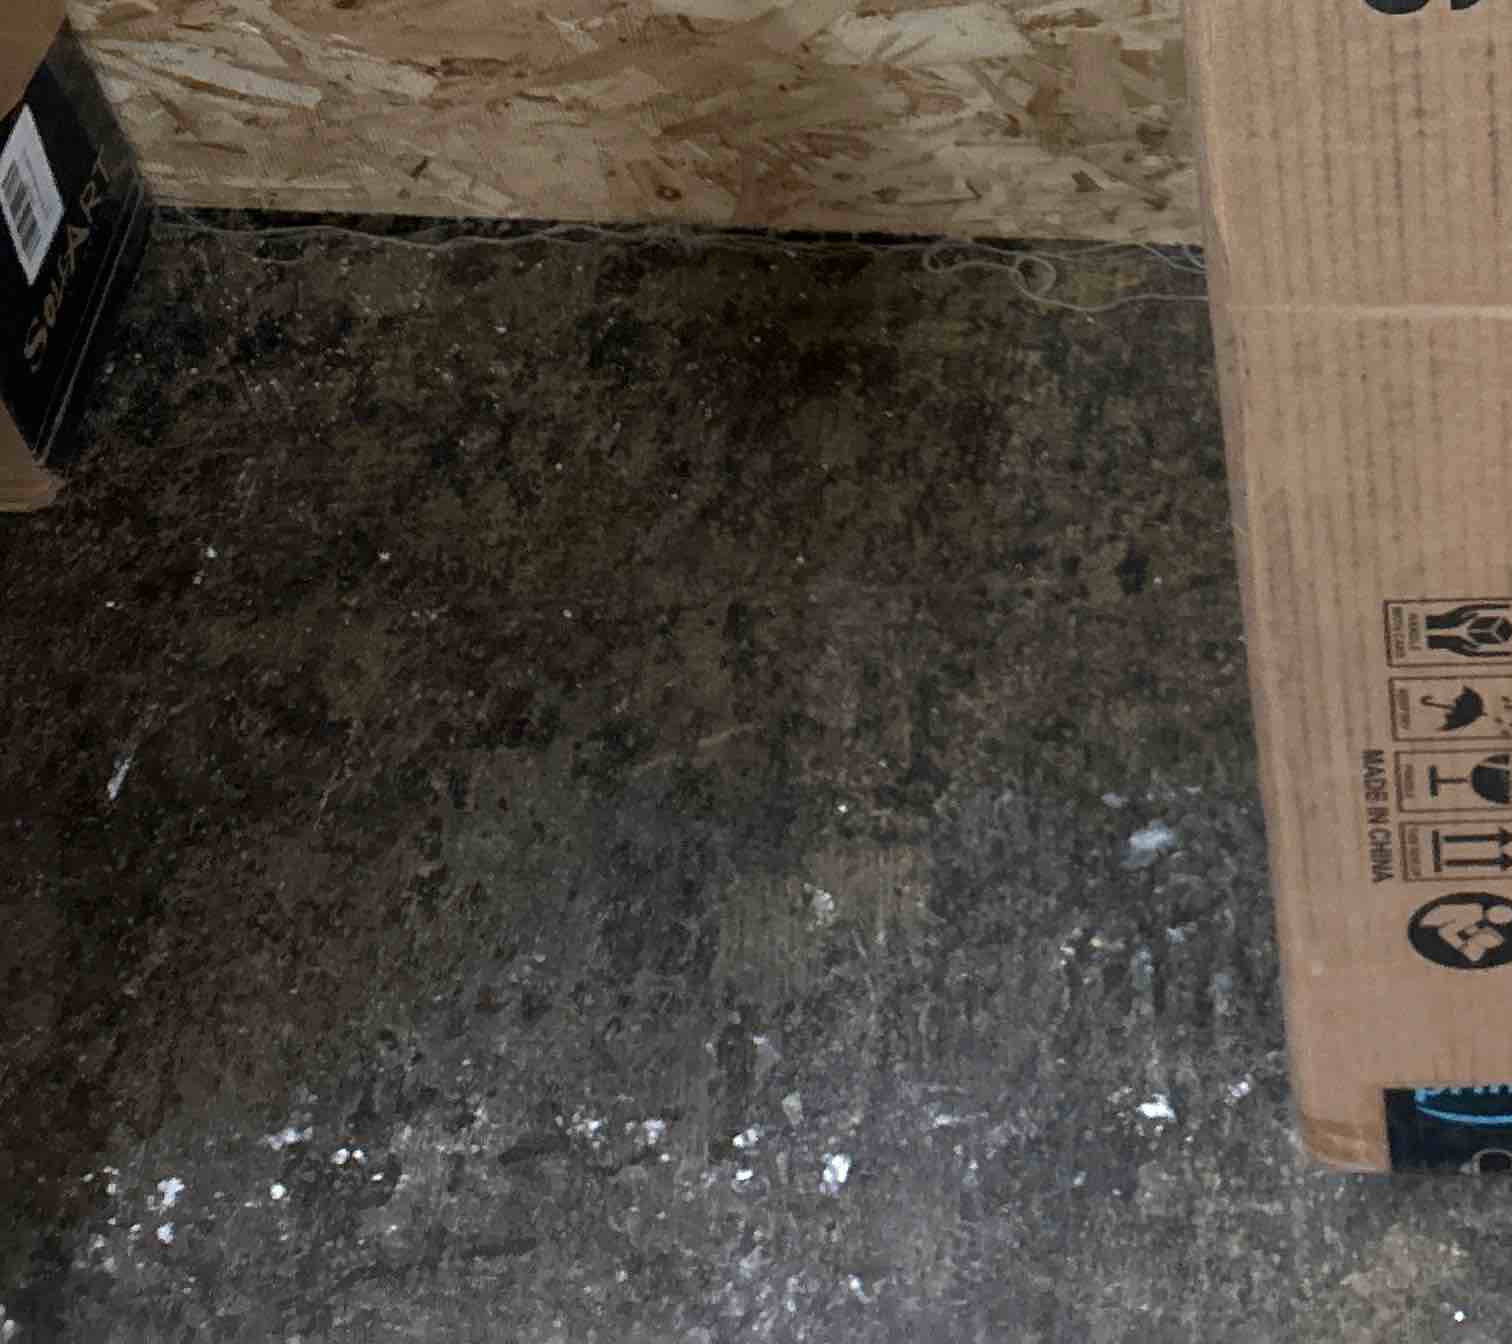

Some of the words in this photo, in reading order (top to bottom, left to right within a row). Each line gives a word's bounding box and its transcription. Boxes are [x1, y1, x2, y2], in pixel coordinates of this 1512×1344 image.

[1361, 749, 1388, 802] MADE
[1366, 807, 1390, 824] IN
[1367, 828, 1395, 884] CHINA
